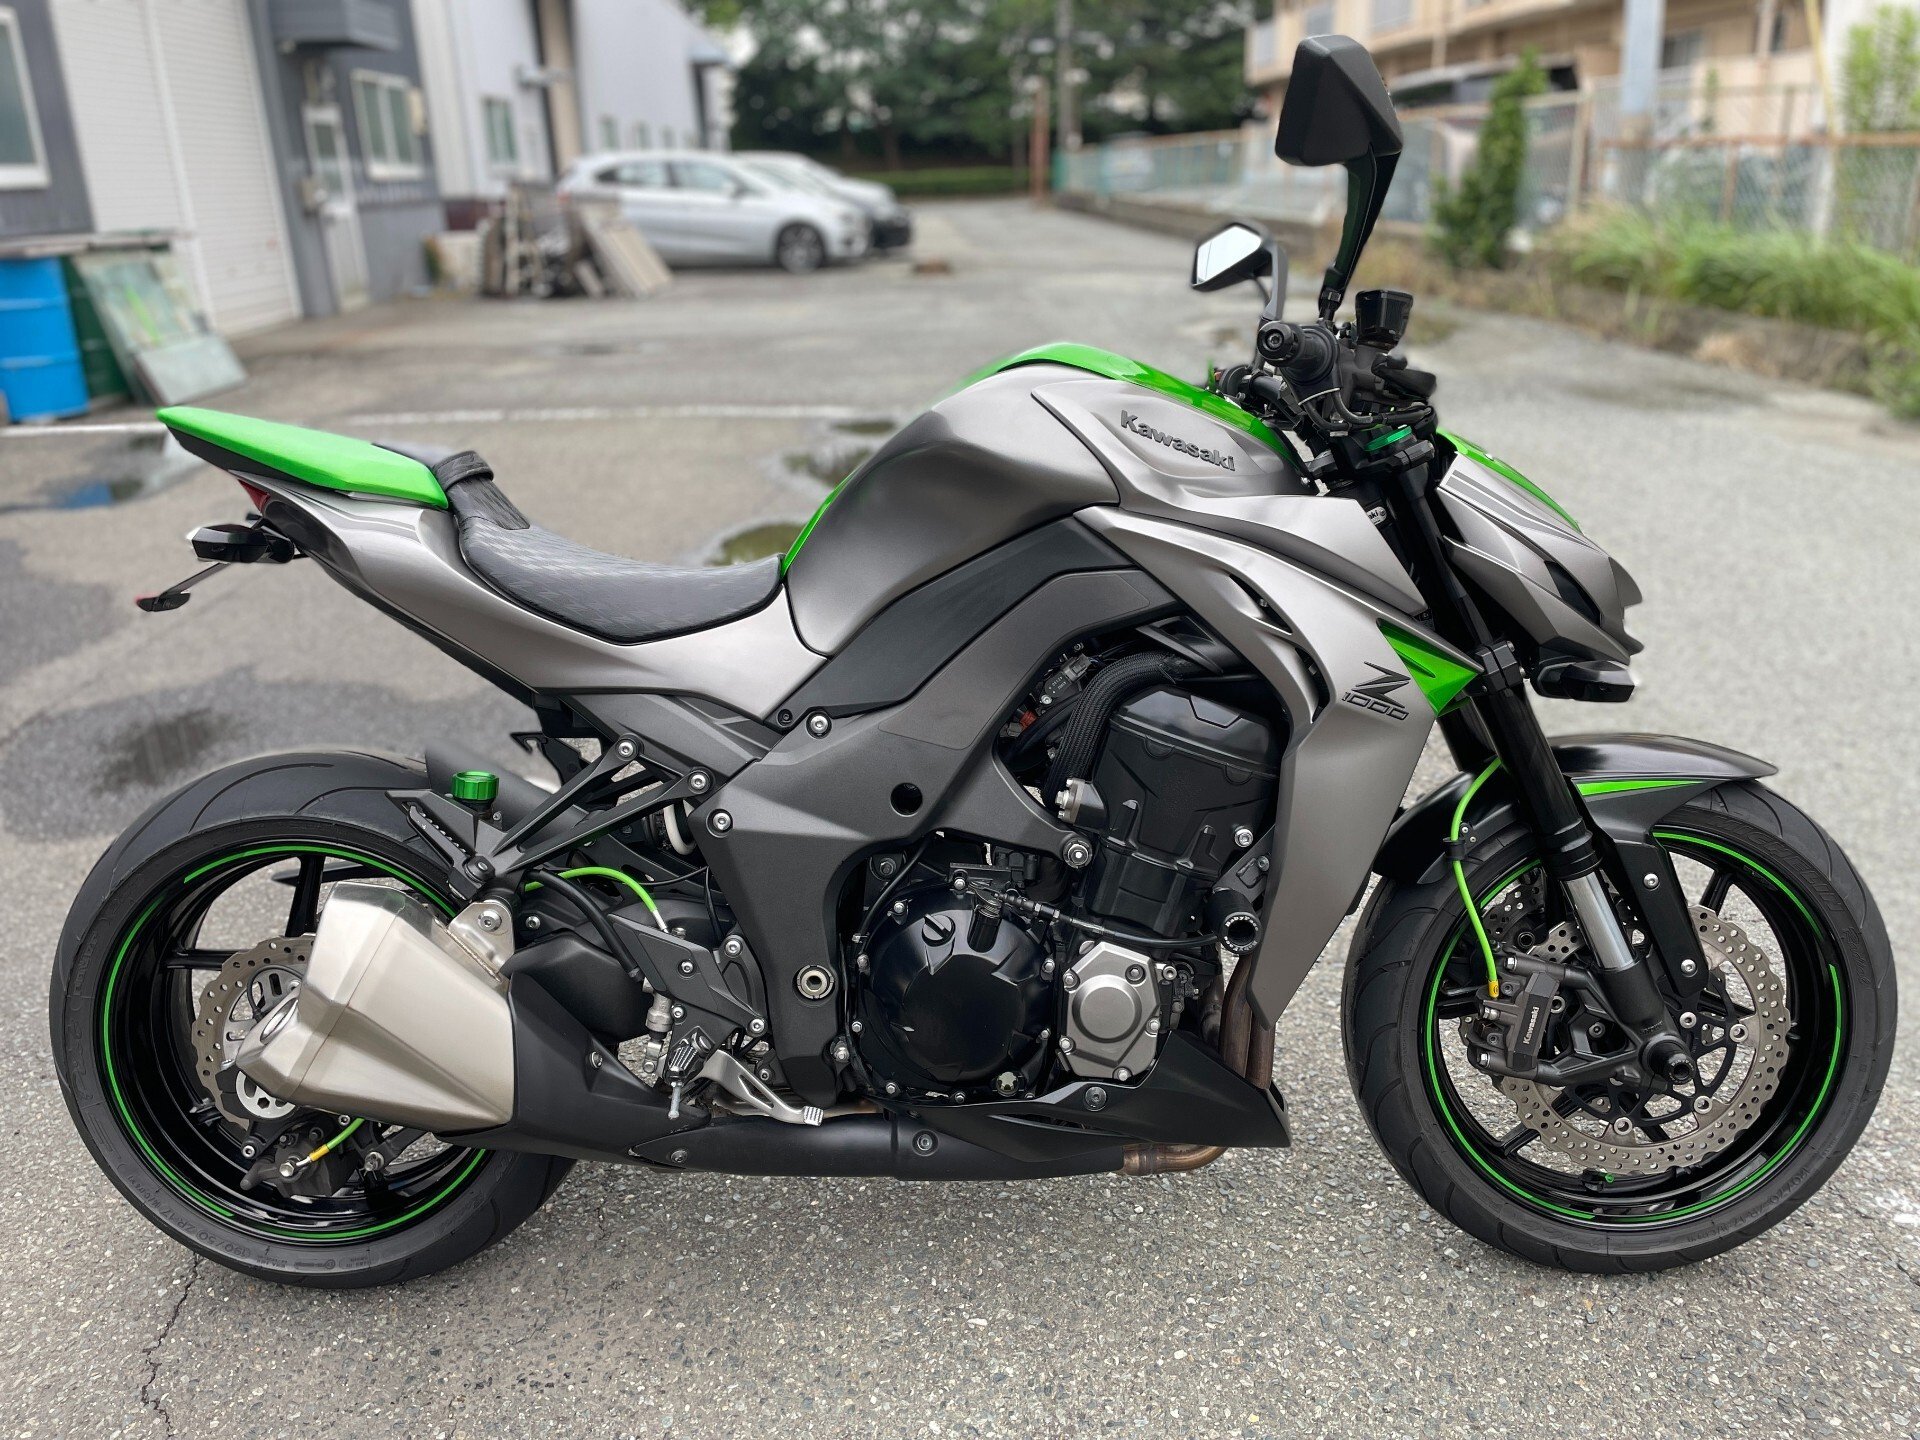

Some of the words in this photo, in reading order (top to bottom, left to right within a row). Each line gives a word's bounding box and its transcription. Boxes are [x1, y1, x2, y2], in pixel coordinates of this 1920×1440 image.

[1120, 410, 1236, 472] Kawasaki
[1341, 691, 1409, 720] 1000
[1351, 661, 1411, 708] Z
[1706, 816, 1846, 913] MICHELIN
[1523, 1006, 1540, 1045] Kawasaki
[198, 1230, 248, 1257] 190/50
